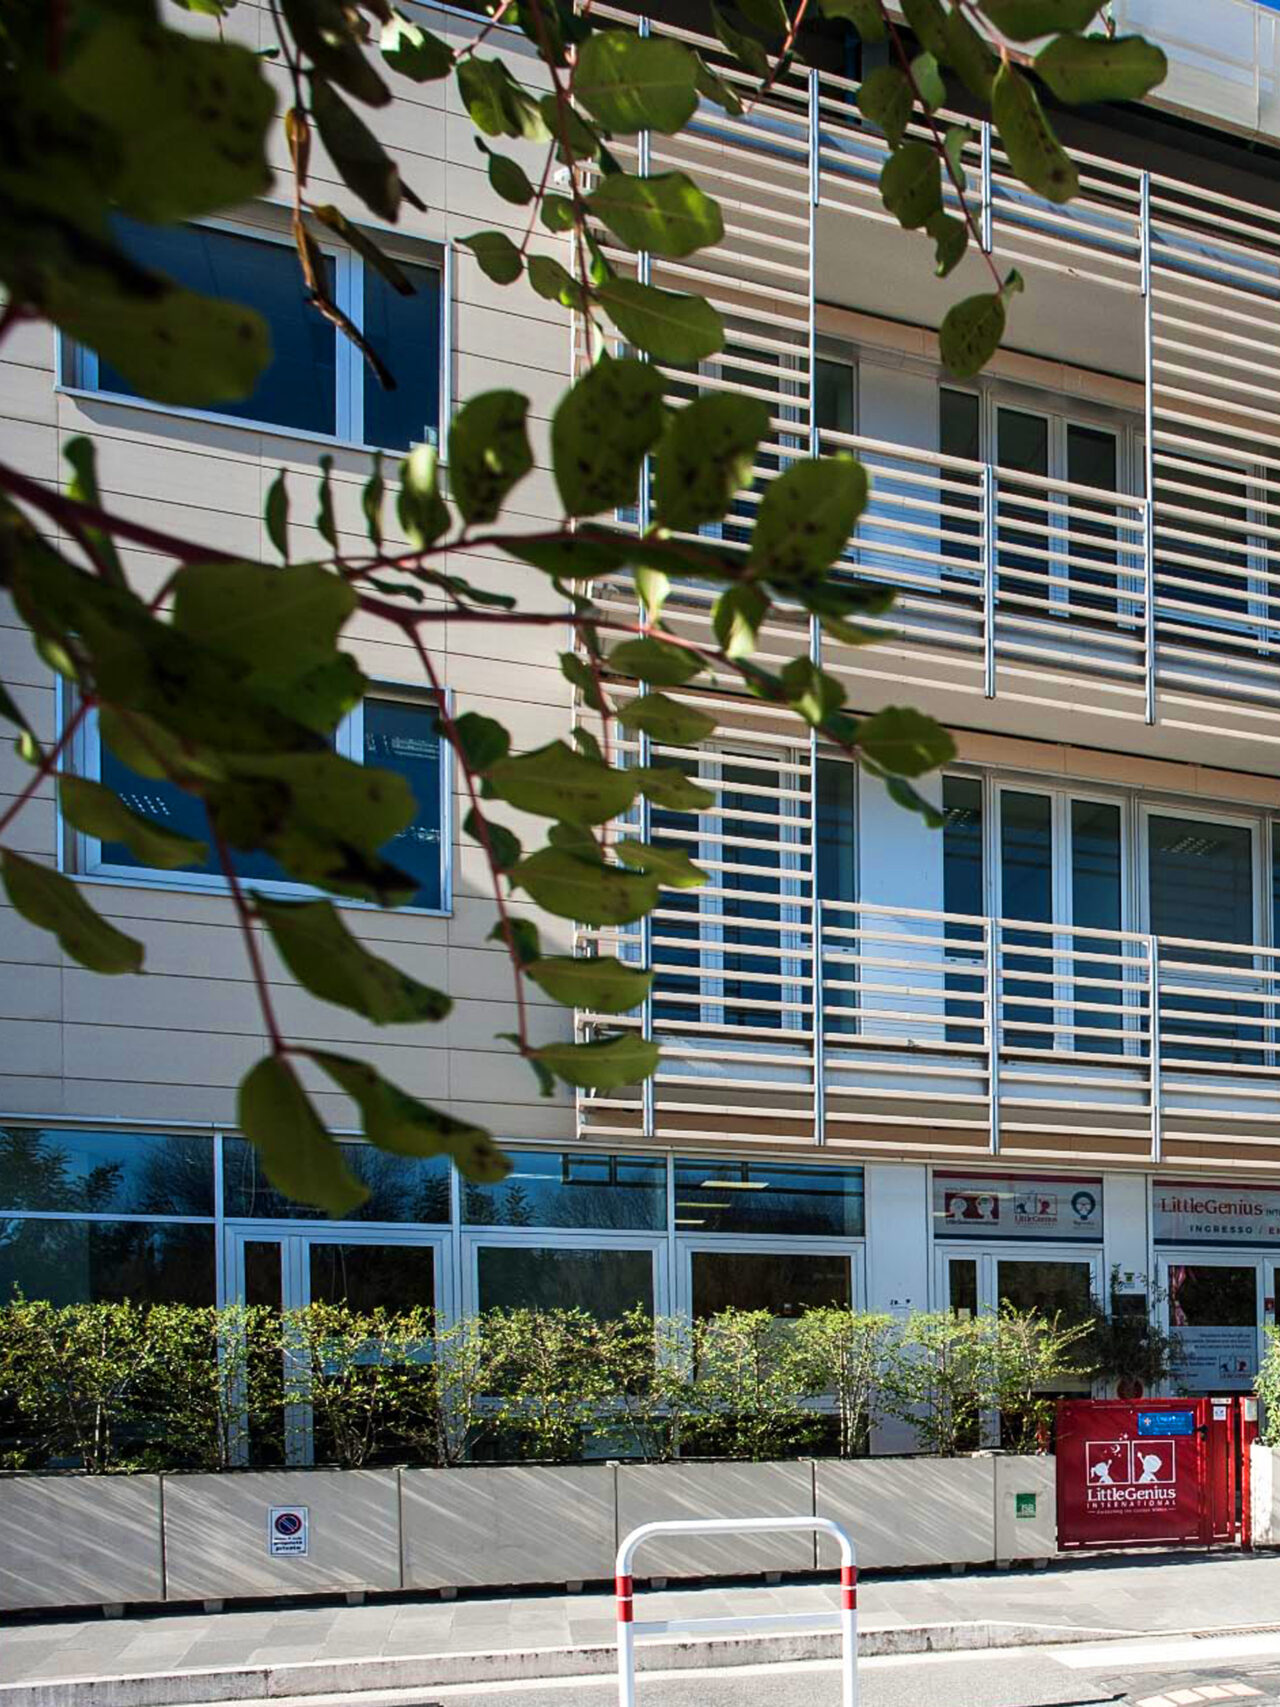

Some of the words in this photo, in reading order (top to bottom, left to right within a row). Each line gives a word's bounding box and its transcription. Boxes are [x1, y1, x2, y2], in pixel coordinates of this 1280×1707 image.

[1161, 1197, 1263, 1216] LittleGenius
[1189, 1224, 1253, 1235] INGRESSO
[1088, 1485, 1176, 1501] LittleGenius
[1087, 1500, 1176, 1509] INTERNATIONAL
